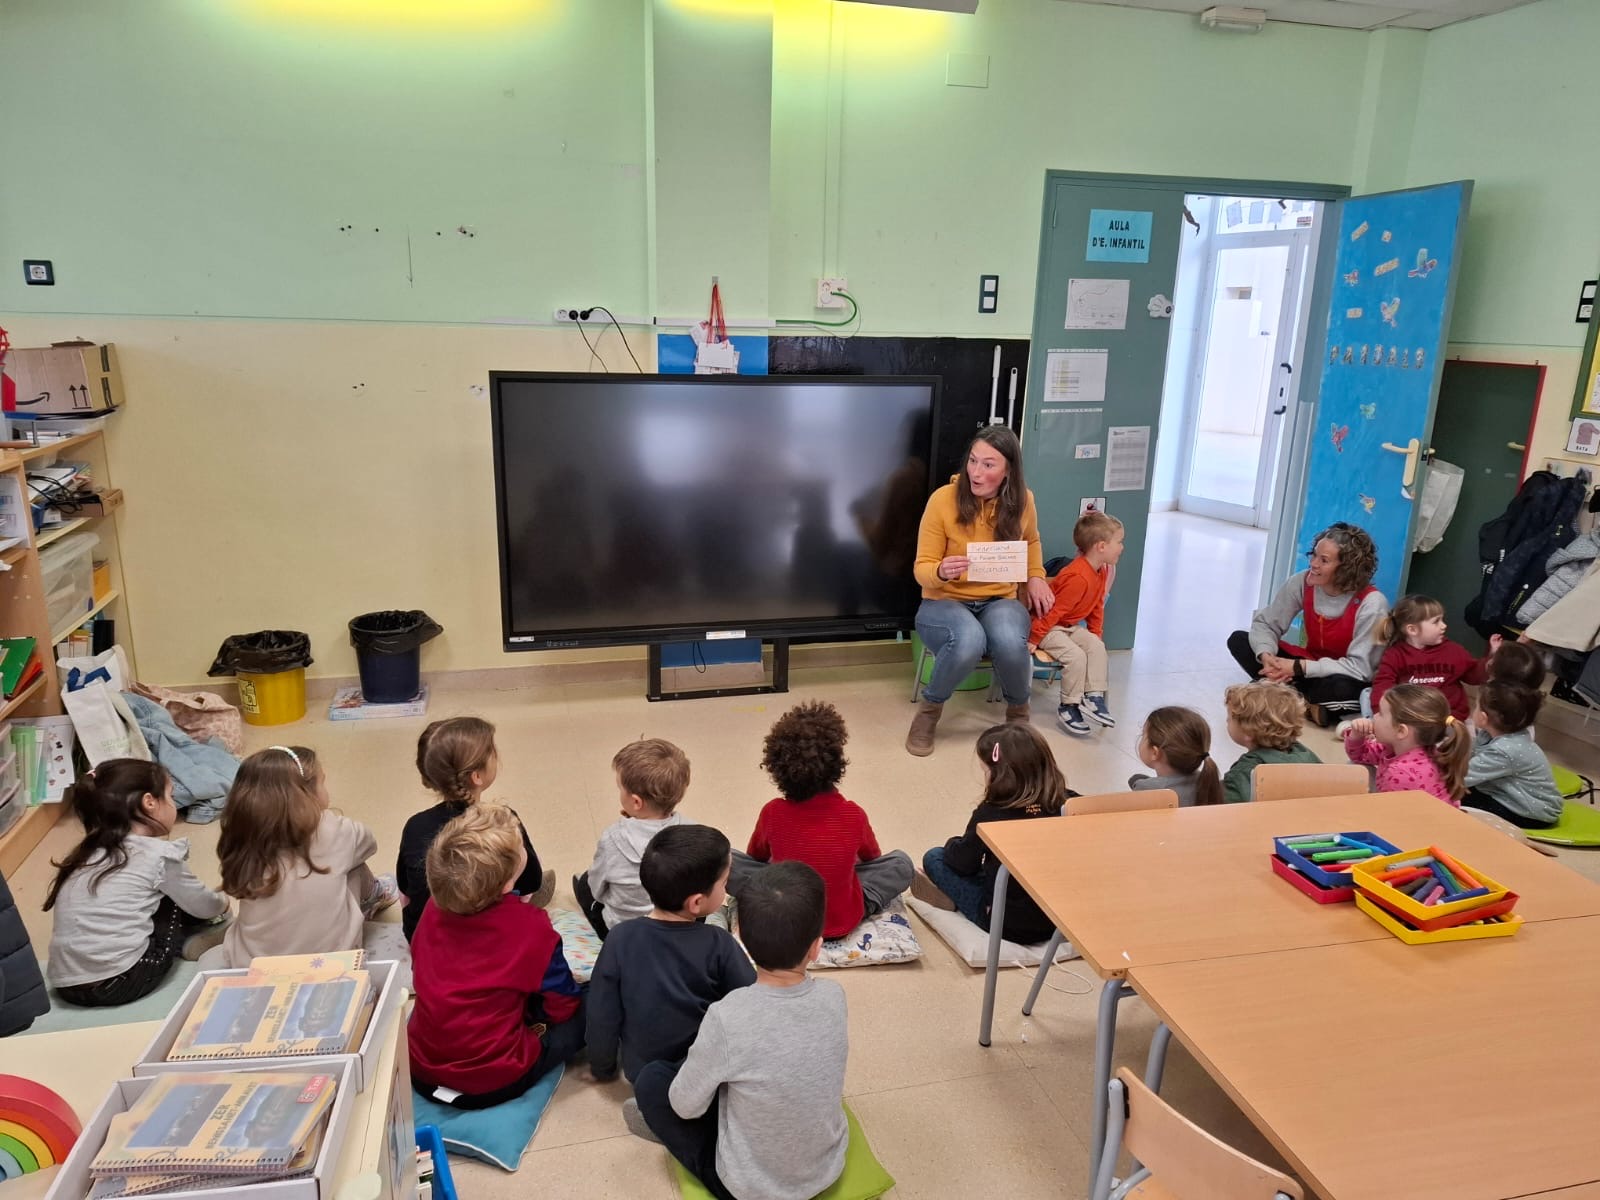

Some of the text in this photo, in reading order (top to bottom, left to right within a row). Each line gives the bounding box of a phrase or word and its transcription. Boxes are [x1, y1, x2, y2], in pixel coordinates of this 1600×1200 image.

[1109, 220, 1130, 231] AULA
[1092, 237, 1145, 249] D'E. INFANTIL
[211, 1104, 231, 1121] ZER
